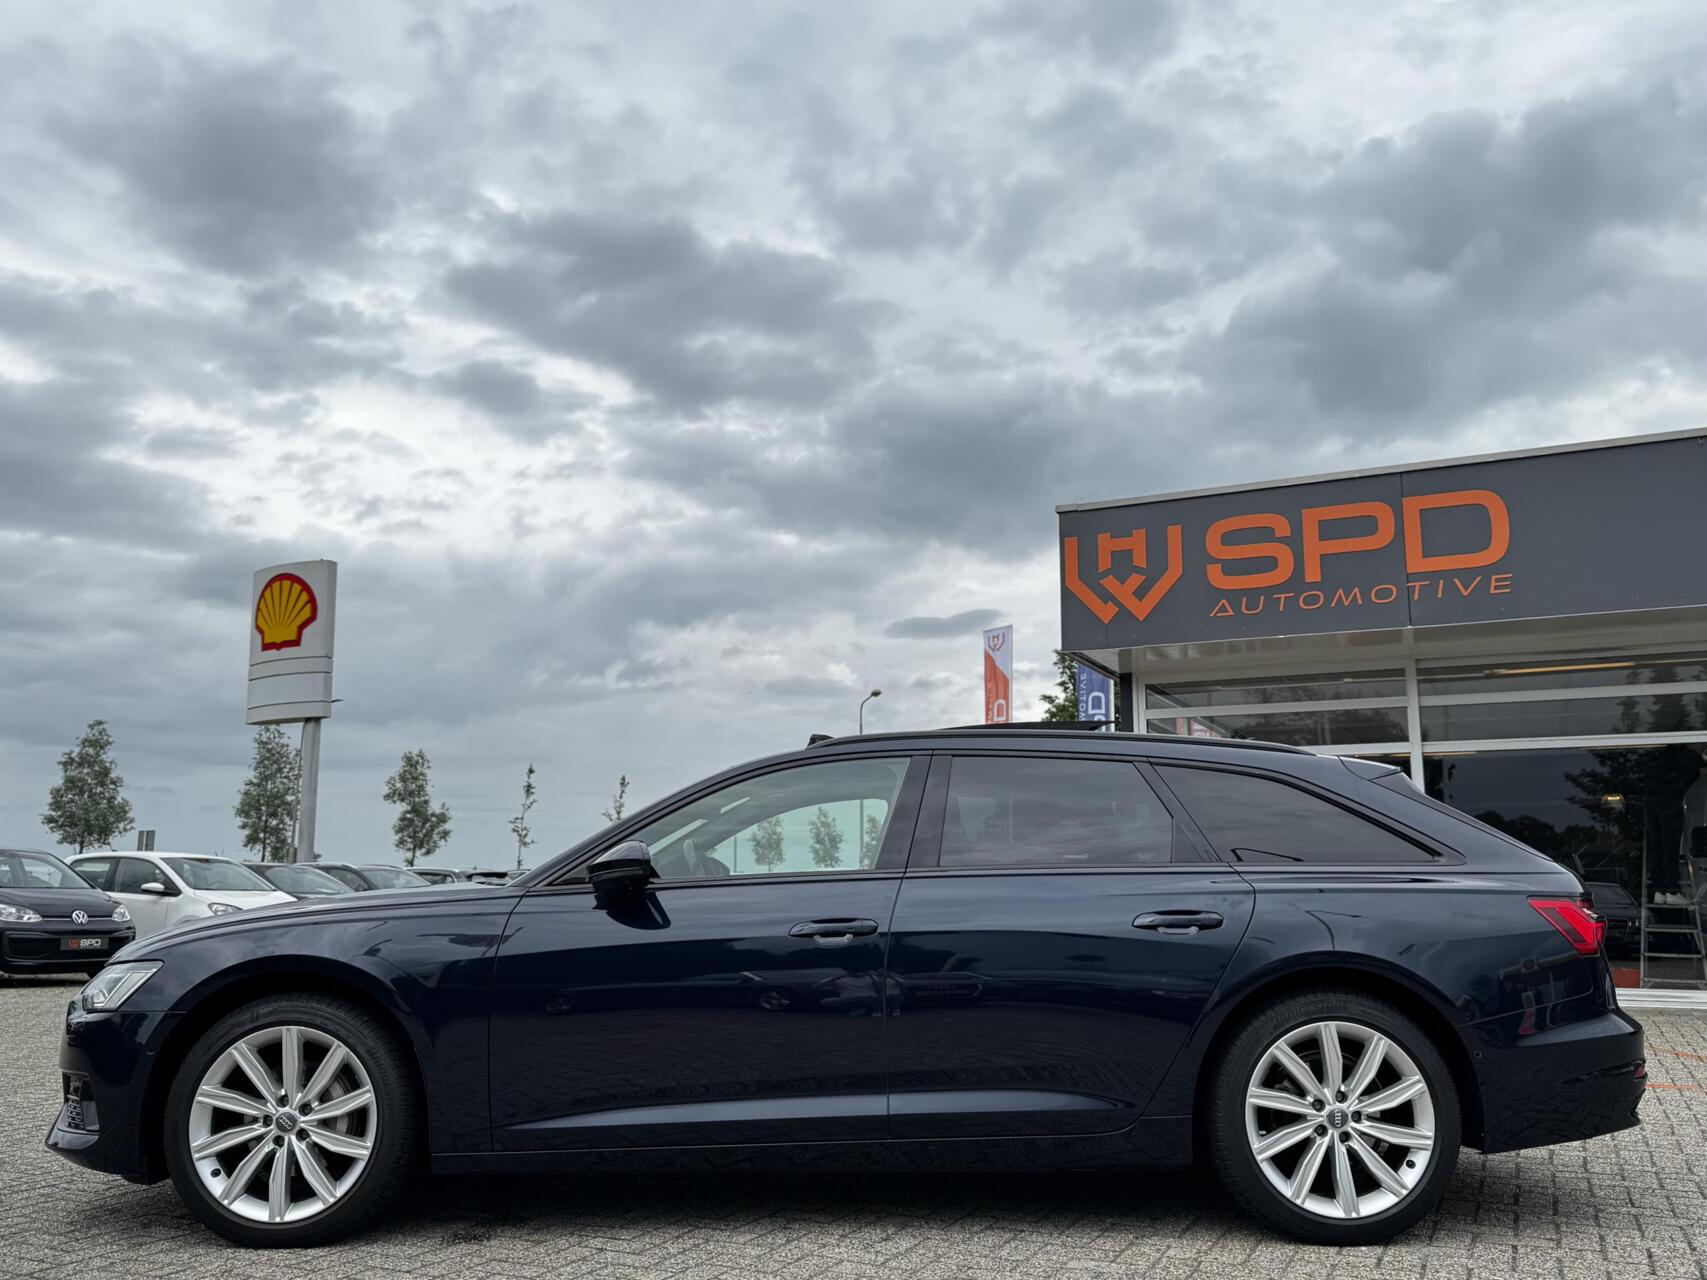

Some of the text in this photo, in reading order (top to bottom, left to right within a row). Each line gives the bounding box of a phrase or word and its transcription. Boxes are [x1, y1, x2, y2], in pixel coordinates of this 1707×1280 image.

[1205, 489, 1510, 590] SPD
[1209, 574, 1513, 617] AUTOMOTIVE
[80, 938, 101, 947] SPD
